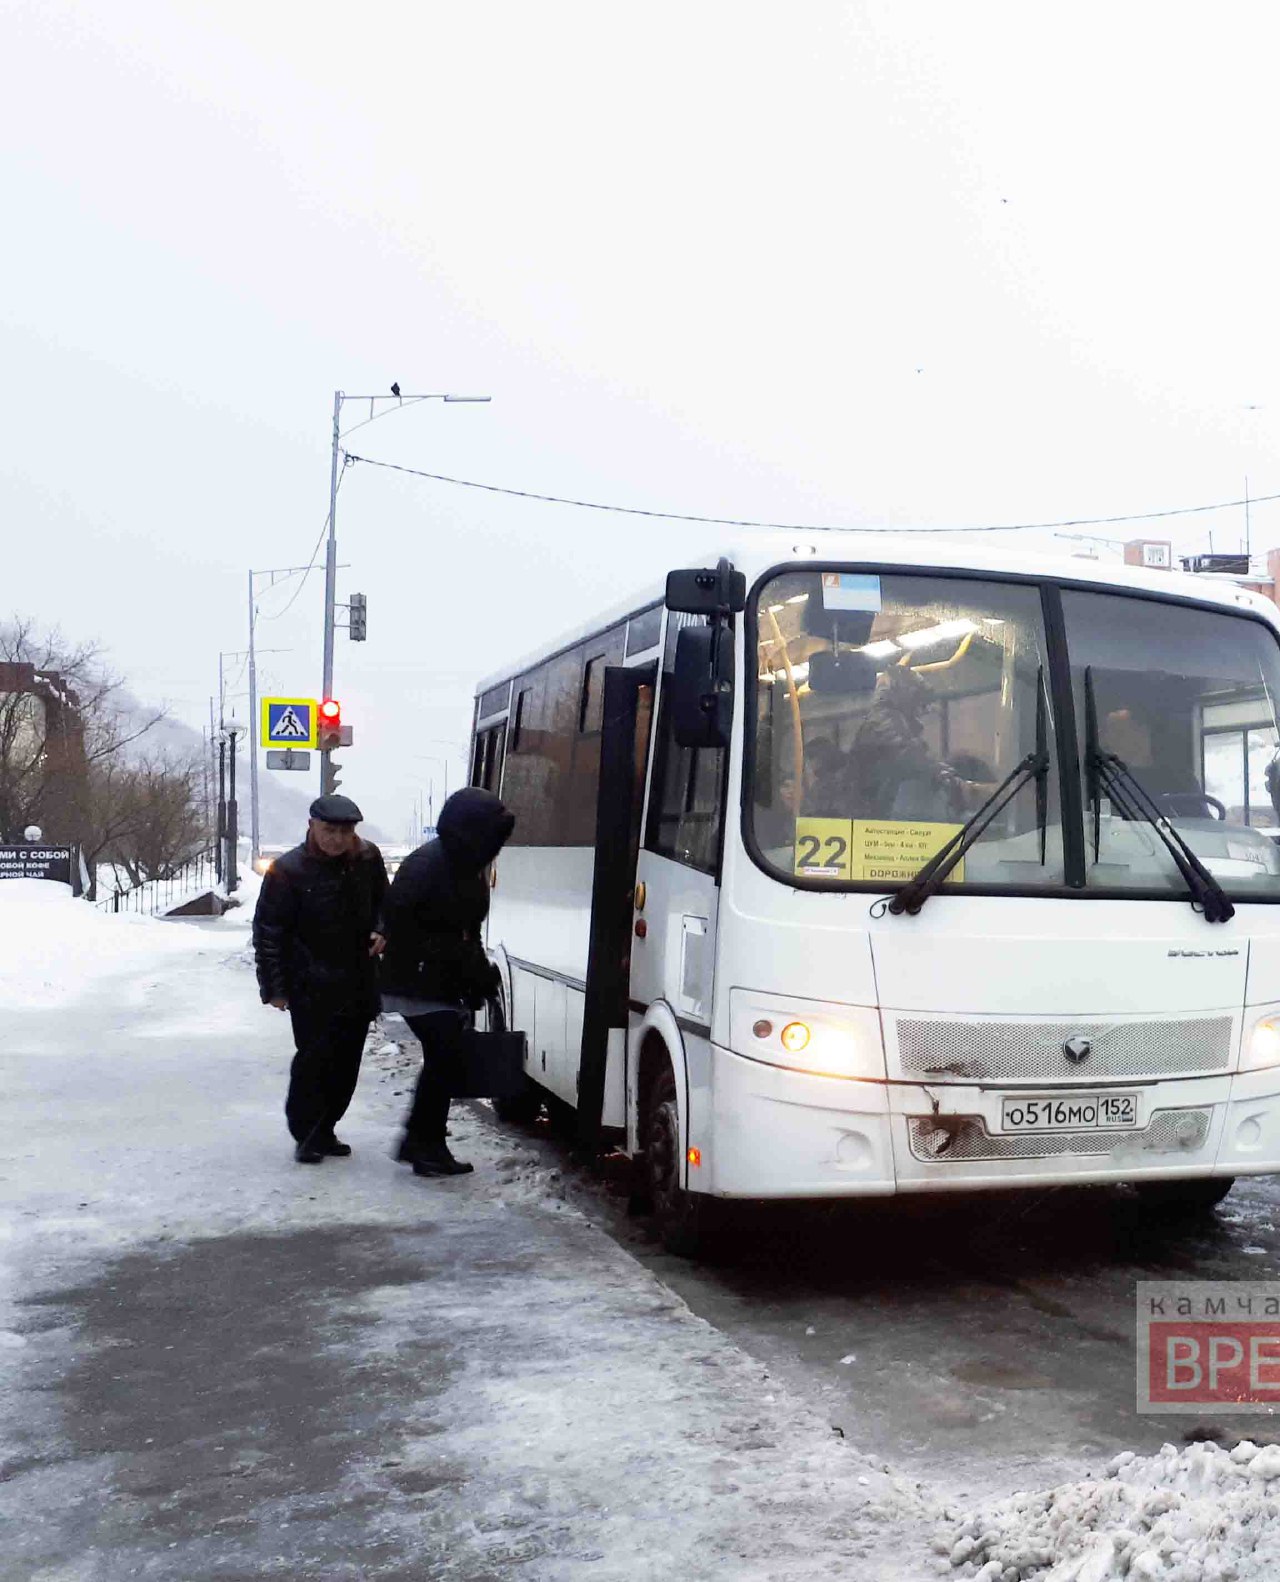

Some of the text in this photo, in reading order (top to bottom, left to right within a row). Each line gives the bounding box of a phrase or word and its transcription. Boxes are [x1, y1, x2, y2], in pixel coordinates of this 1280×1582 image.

[20, 851, 28, 860] С
[30, 850, 70, 860] СОБОЙ
[797, 835, 847, 869] 22
[1010, 1098, 1131, 1126] О516МО 152
